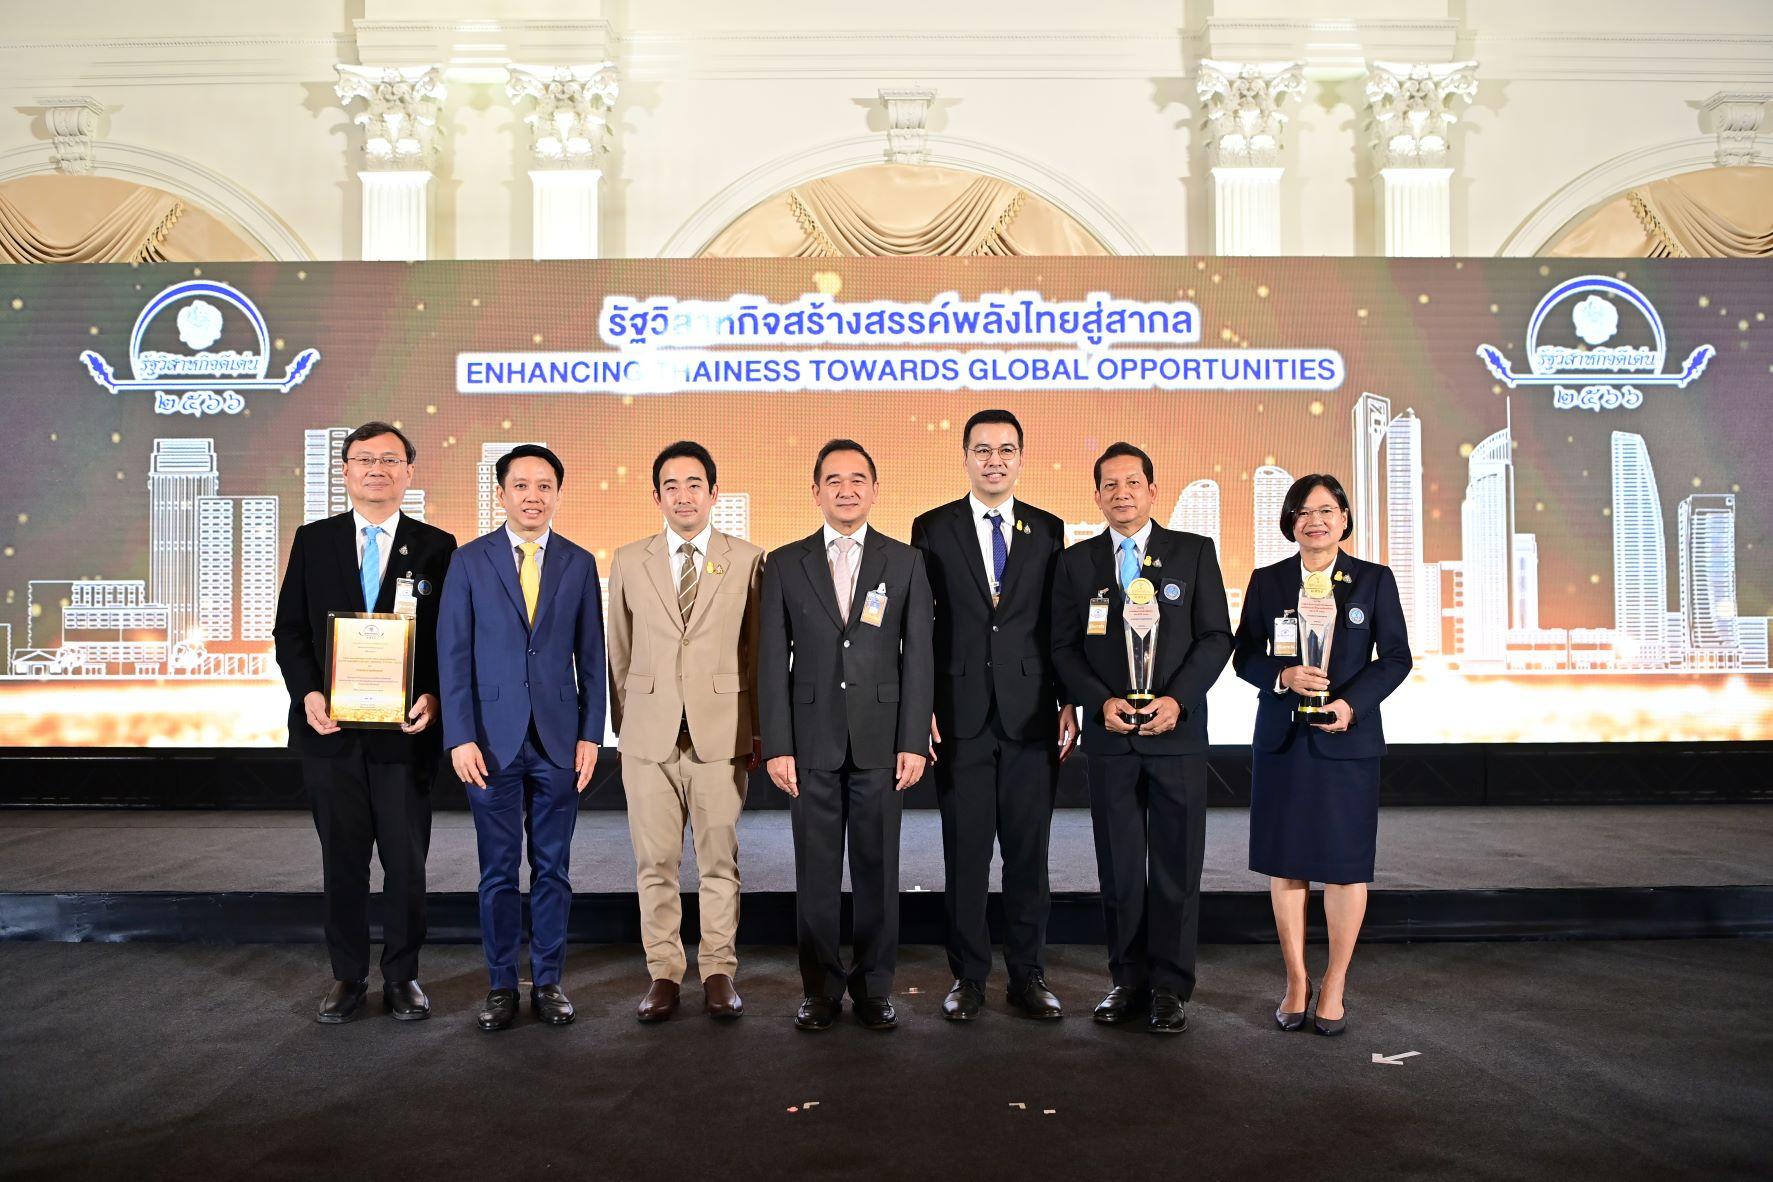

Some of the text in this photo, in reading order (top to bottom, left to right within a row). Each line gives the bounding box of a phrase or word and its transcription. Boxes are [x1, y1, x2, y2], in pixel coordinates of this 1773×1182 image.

[809, 358, 960, 382] TOWARDS
[968, 358, 1089, 381] GLOBAL
[1096, 357, 1336, 381] OPPORTUNITIES
